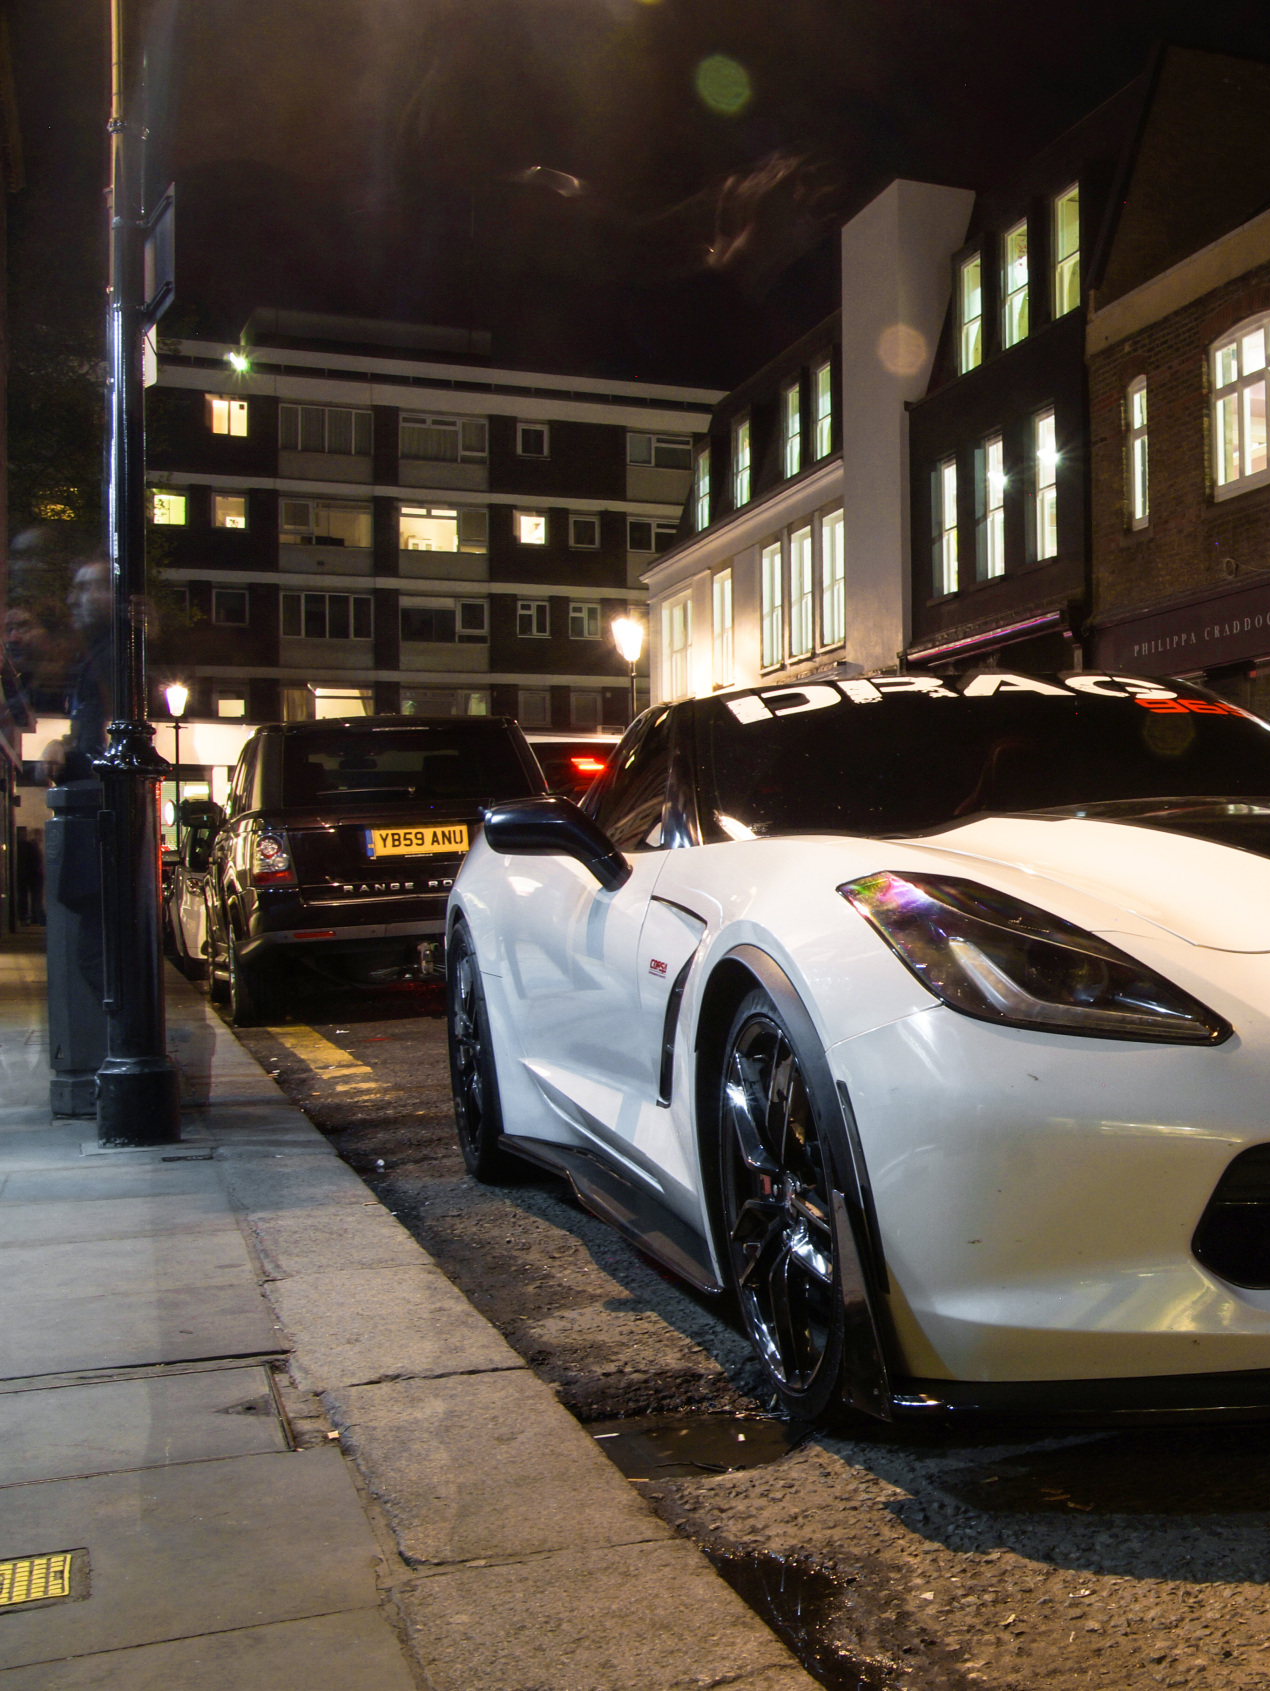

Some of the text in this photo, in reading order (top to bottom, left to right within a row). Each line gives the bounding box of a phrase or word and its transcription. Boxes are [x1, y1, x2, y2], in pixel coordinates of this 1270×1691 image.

[1134, 632, 1196, 657] PHILIPPA
[727, 673, 1178, 725] DRAG
[379, 829, 463, 848] YB59 ANU
[343, 882, 414, 893] RANGE
